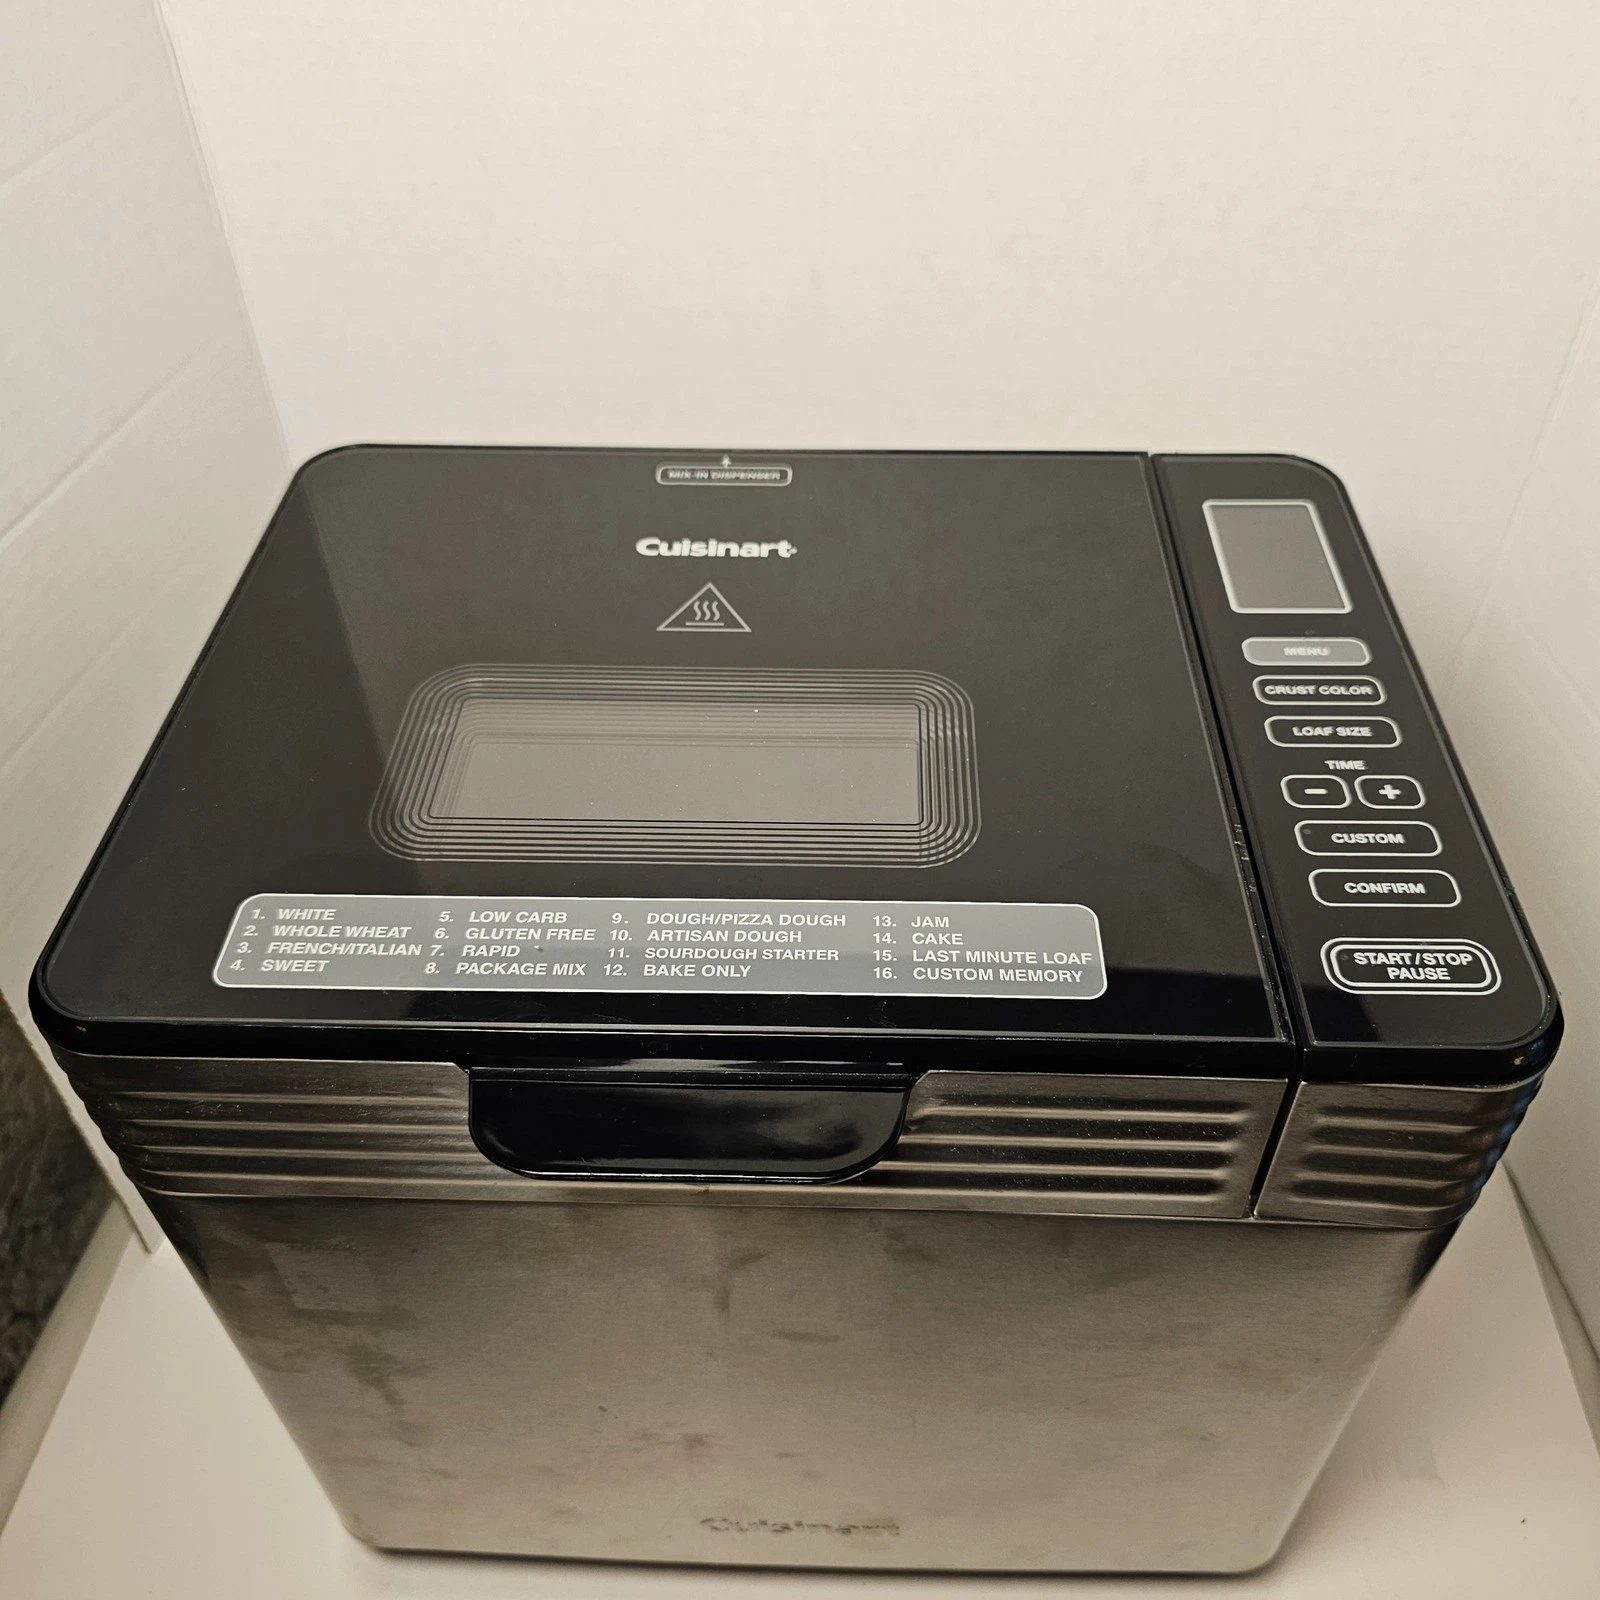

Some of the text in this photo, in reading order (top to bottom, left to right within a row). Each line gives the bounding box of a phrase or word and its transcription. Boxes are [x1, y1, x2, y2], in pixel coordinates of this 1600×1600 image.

[668, 470, 780, 480] MIX-IN DISPENSER
[636, 537, 797, 558] Cuisinart
[1284, 646, 1329, 656] MENU
[1264, 685, 1373, 697] CRUST COLOR
[1293, 726, 1373, 738] LOAF SIZE
[1325, 760, 1365, 770] TIME
[1331, 832, 1404, 845] CUSTOM
[1344, 881, 1425, 894] CONFIRM
[251, 909, 337, 920] 1. WHITE
[439, 911, 567, 924] 5. LOW CARB
[611, 912, 846, 927] 9. DOUGH/PIZZA DOUGH
[872, 915, 949, 928] 13. JAM
[243, 925, 412, 938] 2. WHOLE WHEAT
[434, 927, 595, 940] 6. GLUTEN FREE
[609, 930, 801, 943] 10. ARTISAN DOUGH
[872, 932, 963, 945] 14. CAKE
[237, 942, 421, 956] 3. FRENCH/ITALIAN
[430, 945, 520, 957] 7. RAPID
[608, 947, 839, 960] 11. SOURDOUGH STARTER
[872, 949, 1092, 965] 15. LAST MINUTE LOAF
[230, 959, 329, 972] 4. SWEET
[425, 962, 586, 976] 8. PACKAGE MIX
[603, 964, 751, 977] 12. BAKE ONLY
[872, 967, 1083, 982] 16. CUSTOM MEMORY
[1387, 966, 1450, 980] PAUSE
